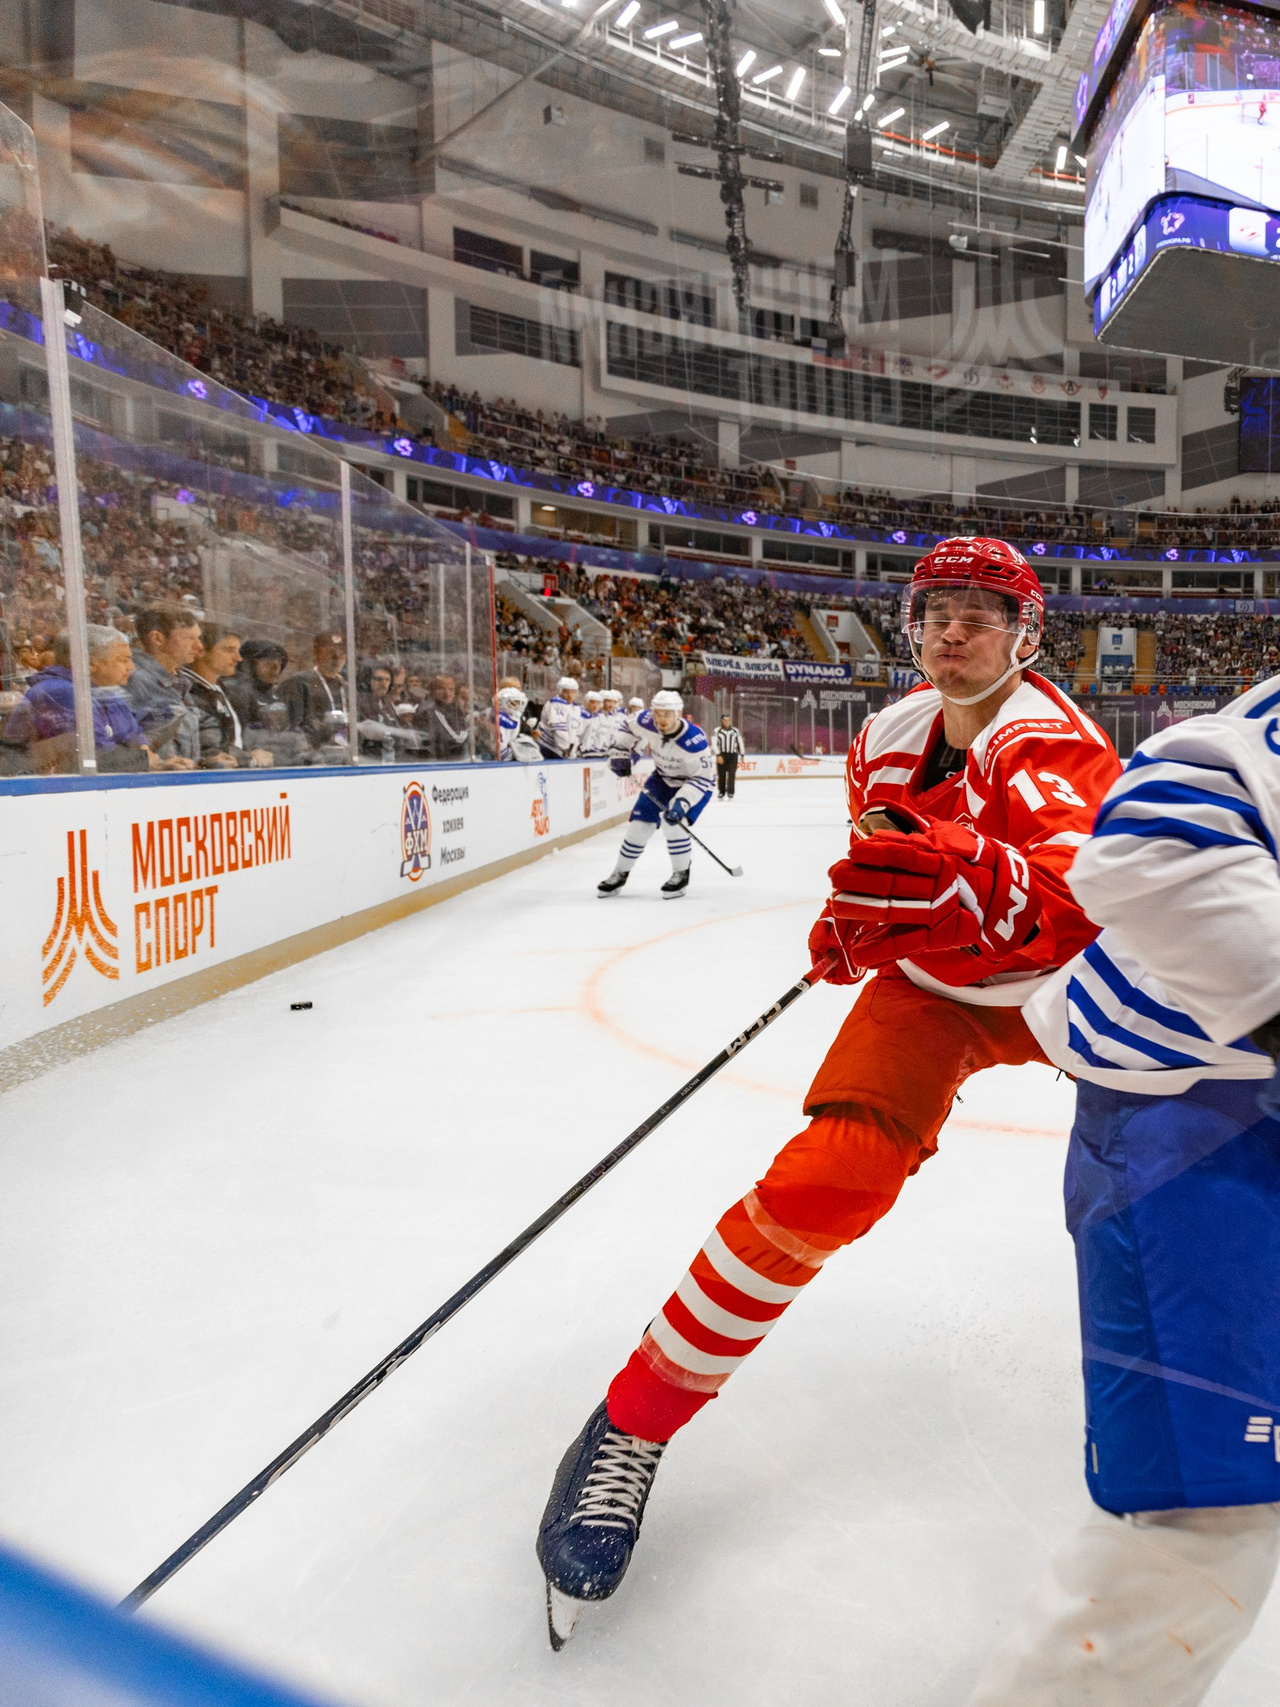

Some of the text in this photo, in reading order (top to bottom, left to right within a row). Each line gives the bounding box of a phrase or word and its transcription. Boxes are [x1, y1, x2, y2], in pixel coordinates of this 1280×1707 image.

[934, 556, 974, 564] CCM
[785, 664, 845, 677] DYNAMO
[820, 689, 866, 701] МОСКОВСКИЙ
[1174, 699, 1216, 710] МОСКОВСКИЙ
[432, 784, 469, 807] Федерация
[1007, 768, 1087, 813] 13
[530, 799, 543, 819] АВТО
[442, 817, 464, 834] хоккея
[131, 792, 291, 894] МОСКОВСКИЙ
[405, 828, 428, 855] ФХМ
[440, 846, 465, 867] Москвы
[134, 884, 218, 975] СПОРТ
[724, 1002, 782, 1057] CCM
[581, 1124, 650, 1189] RIBCOR
